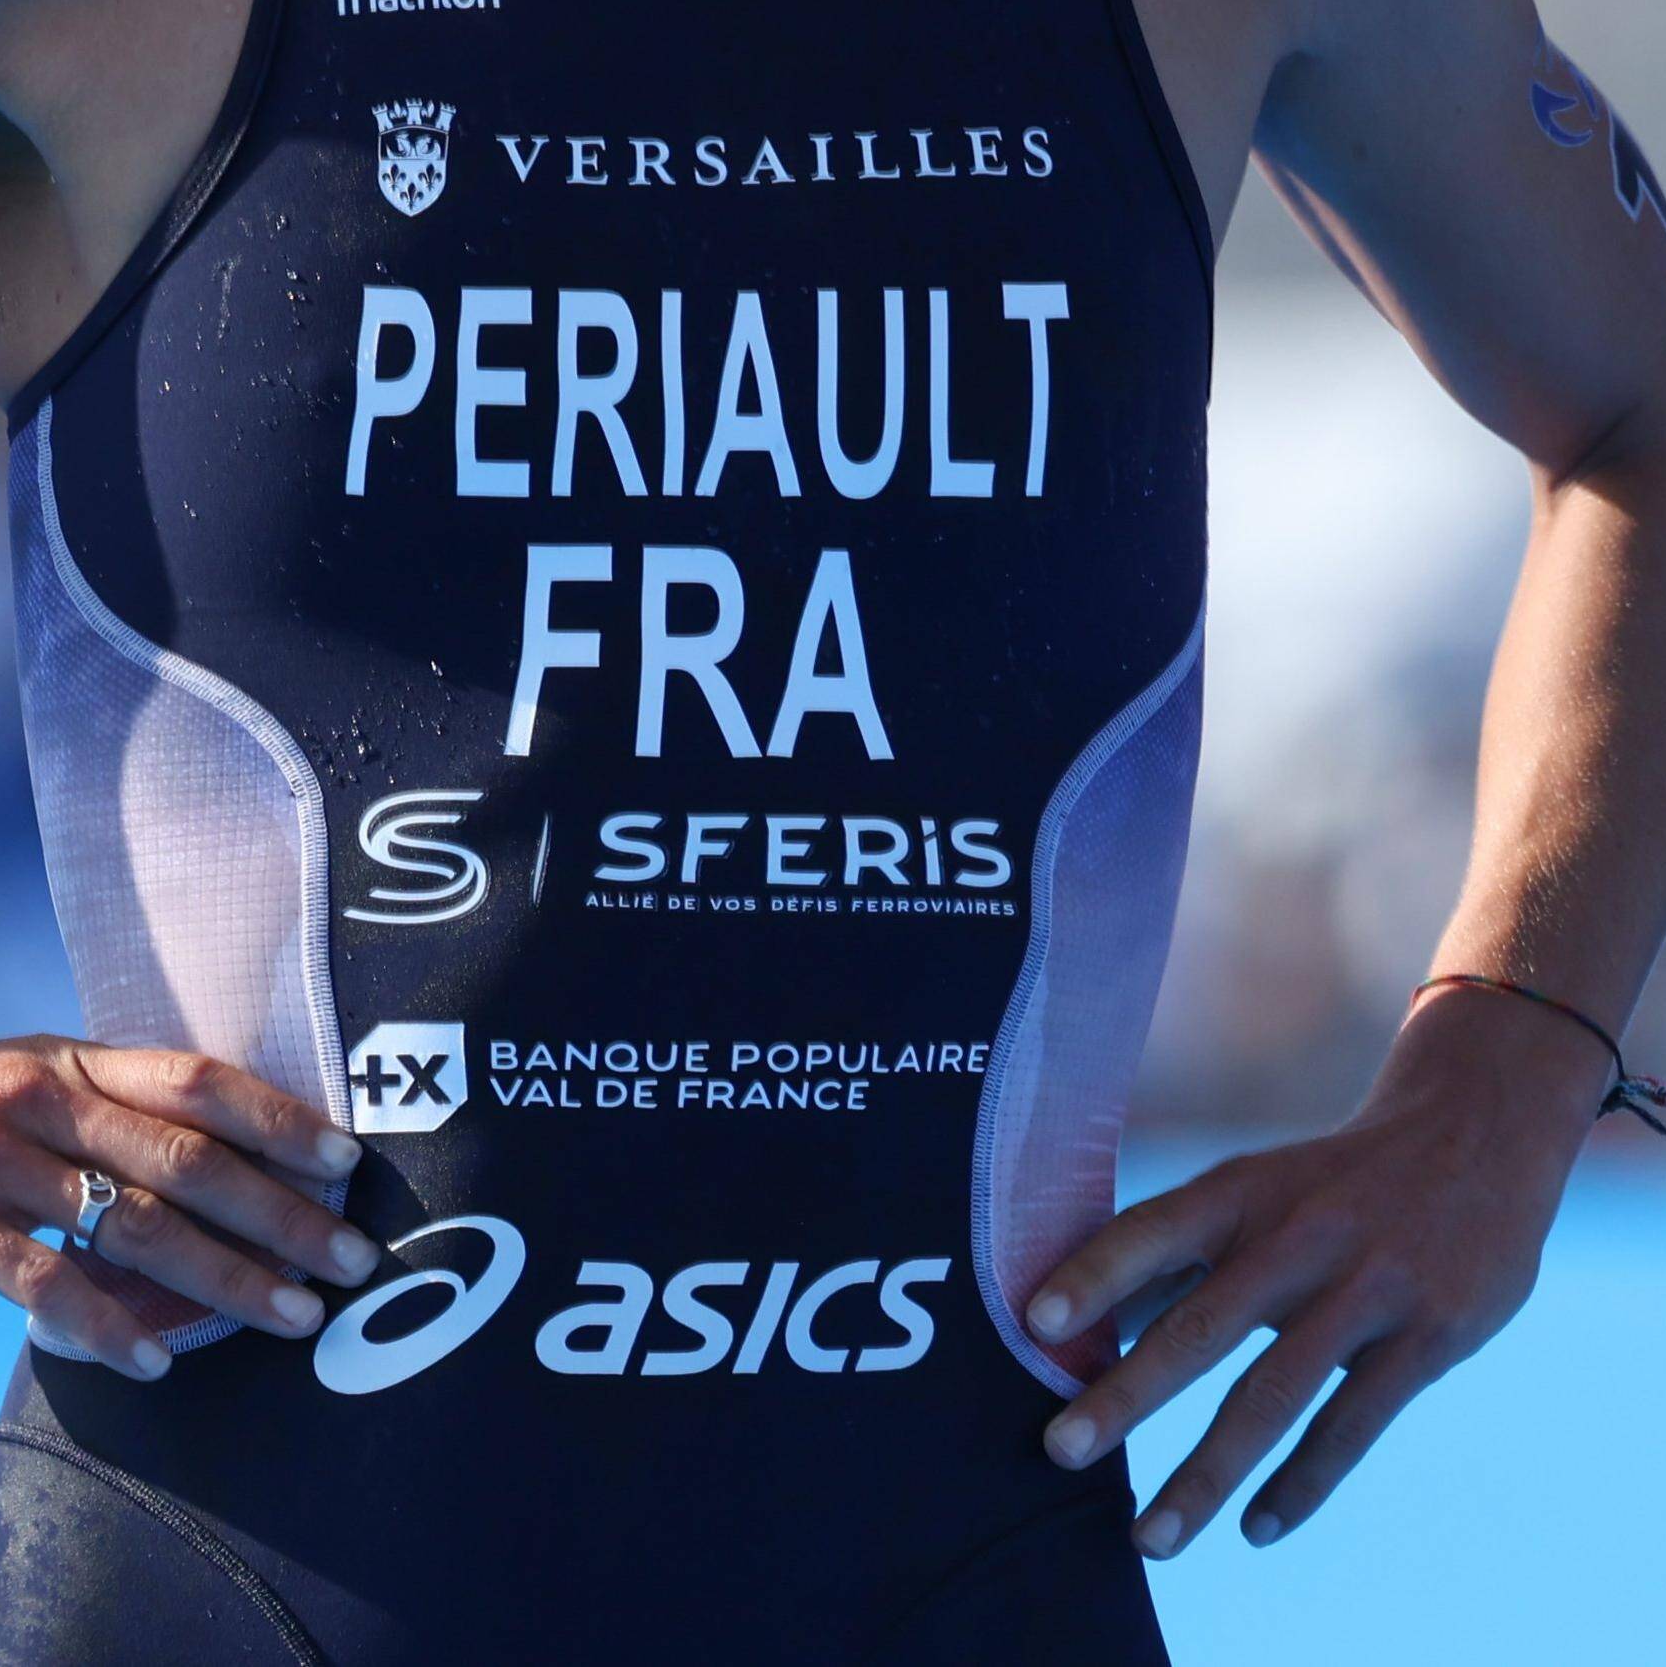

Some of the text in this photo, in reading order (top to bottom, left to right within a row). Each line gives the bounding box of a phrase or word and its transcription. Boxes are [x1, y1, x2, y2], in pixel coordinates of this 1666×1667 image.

[496, 125, 1056, 188] VERSAILLES
[344, 282, 1071, 500] PERIAULT
[503, 542, 895, 761] FRA
[585, 893, 654, 910] ALLIÉ
[668, 896, 697, 911] DE
[709, 897, 757, 912] VOS
[851, 899, 1016, 917] FERROVIAIRES
[490, 1040, 990, 1074] BANQUE POPULAIRE
[490, 1077, 870, 1111] VAL DE FRANCE
